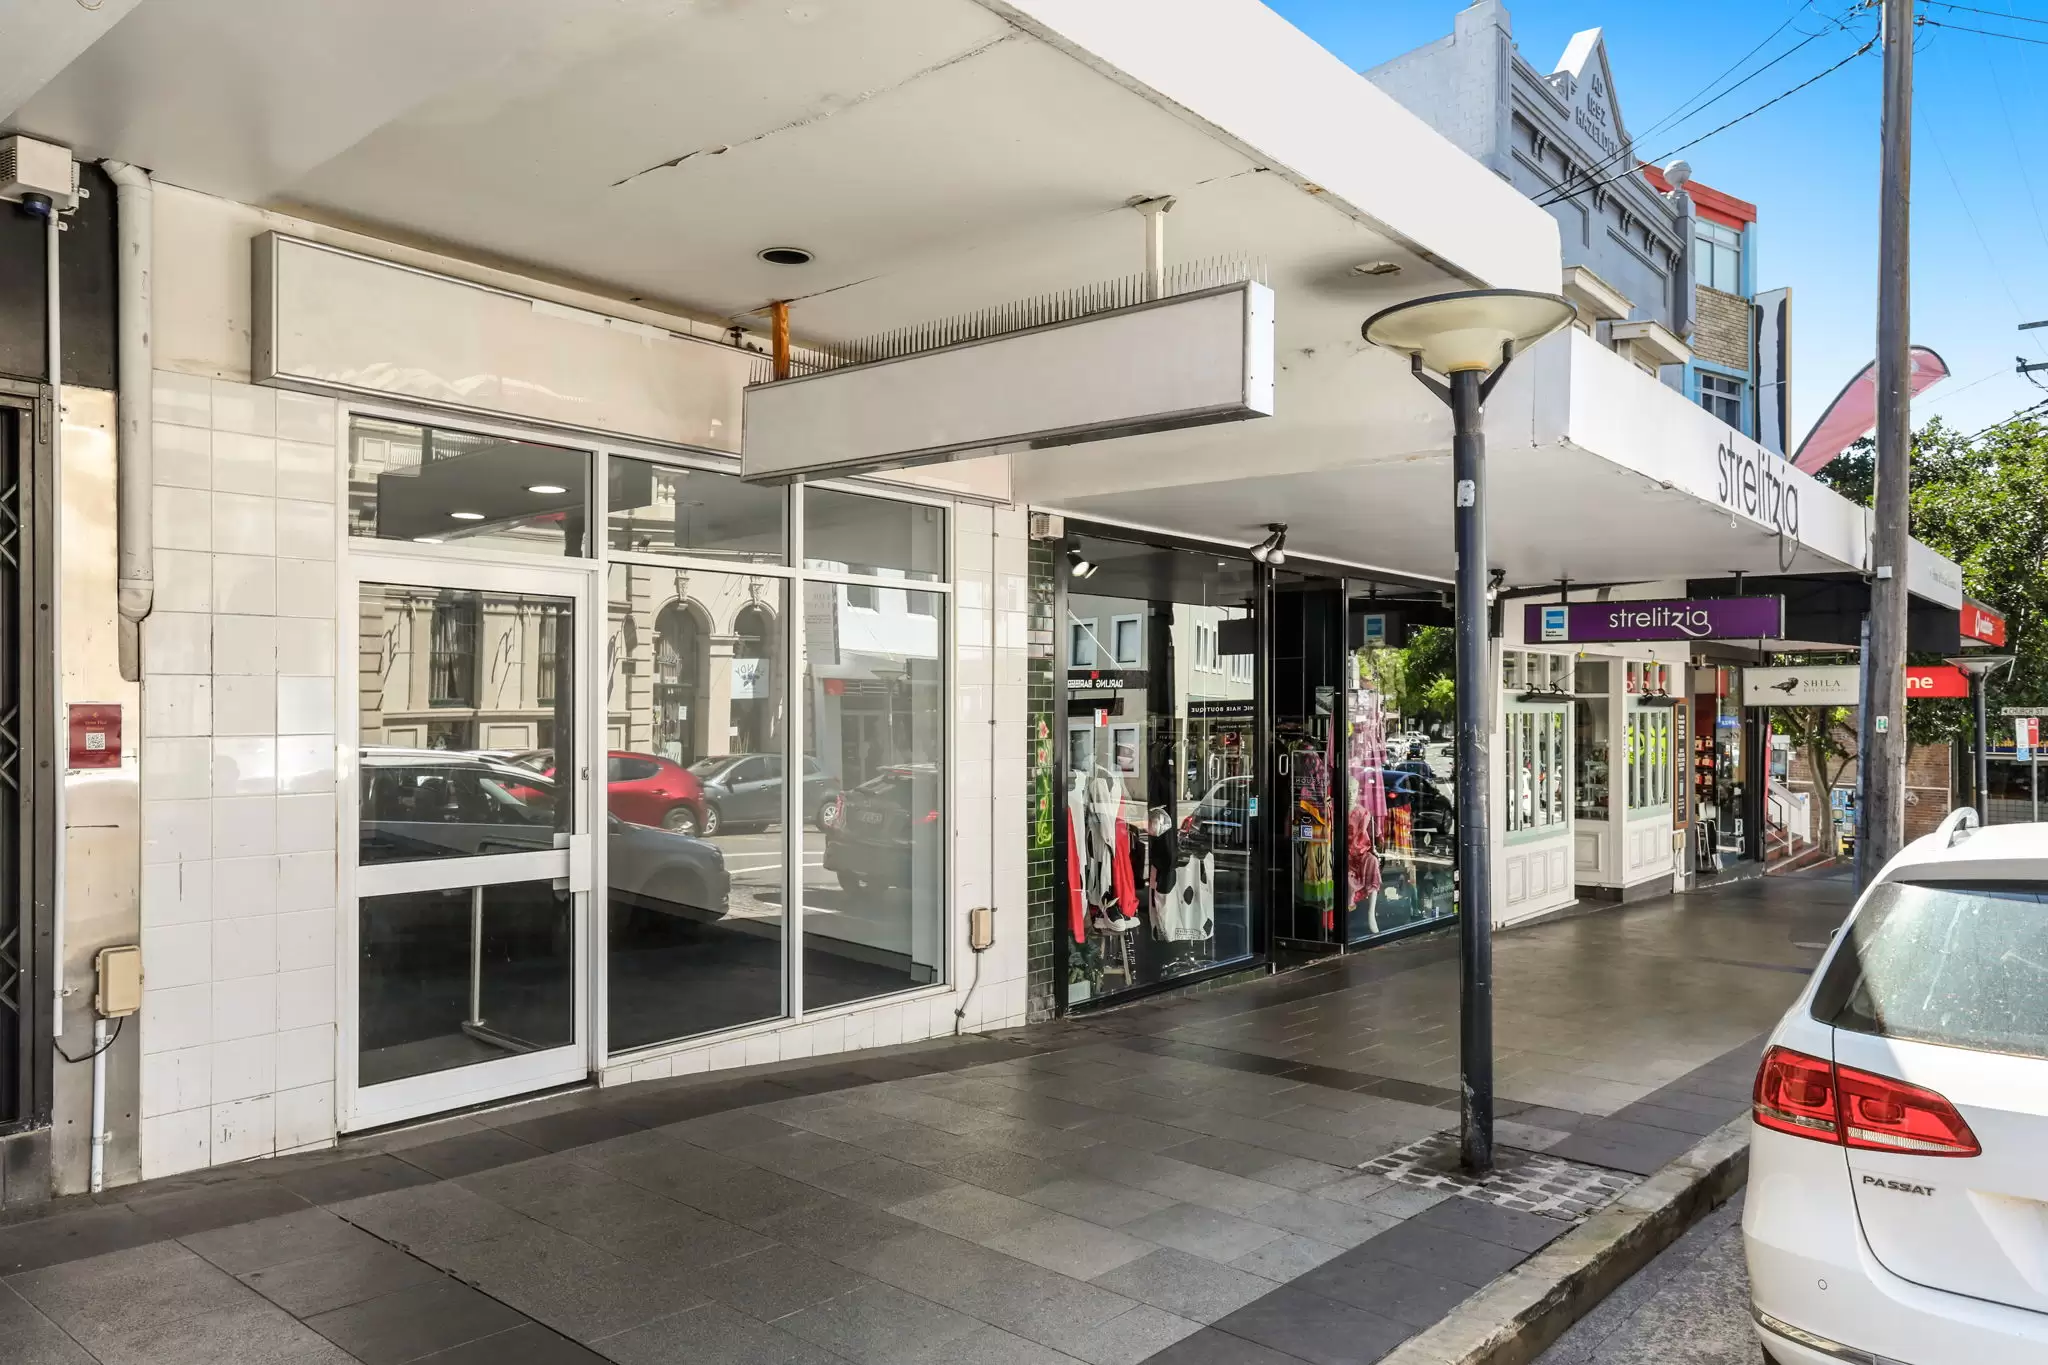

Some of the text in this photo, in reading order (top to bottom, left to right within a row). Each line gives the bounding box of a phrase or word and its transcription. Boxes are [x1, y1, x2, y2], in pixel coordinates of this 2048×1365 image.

[1717, 431, 1800, 572] strelitzia
[1609, 606, 1712, 637] strelitzia
[1803, 679, 1841, 687] SHILA
[1862, 1175, 1936, 1196] PASSAT
